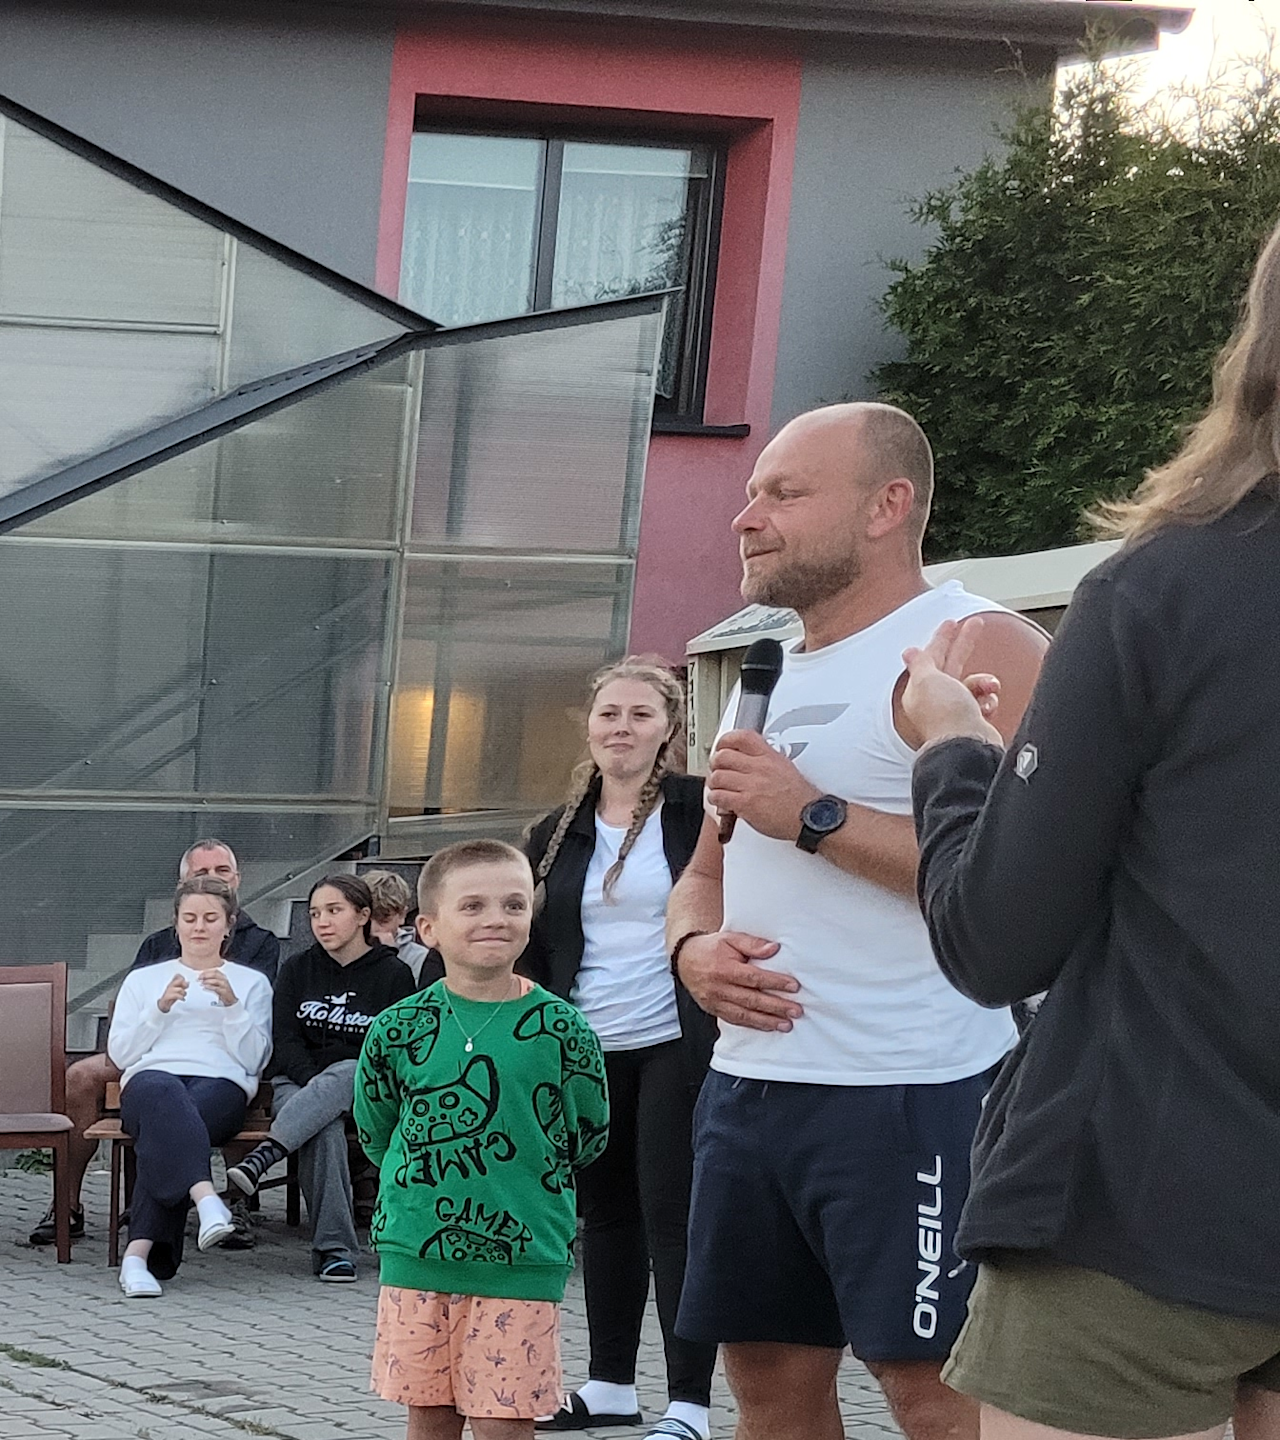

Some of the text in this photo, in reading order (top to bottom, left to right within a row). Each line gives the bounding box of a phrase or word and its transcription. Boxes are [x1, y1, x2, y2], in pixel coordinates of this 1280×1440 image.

[296, 1000, 375, 1026] Hollister
[305, 1020, 365, 1034] CALFORNIA
[435, 1196, 533, 1252] GAMER
